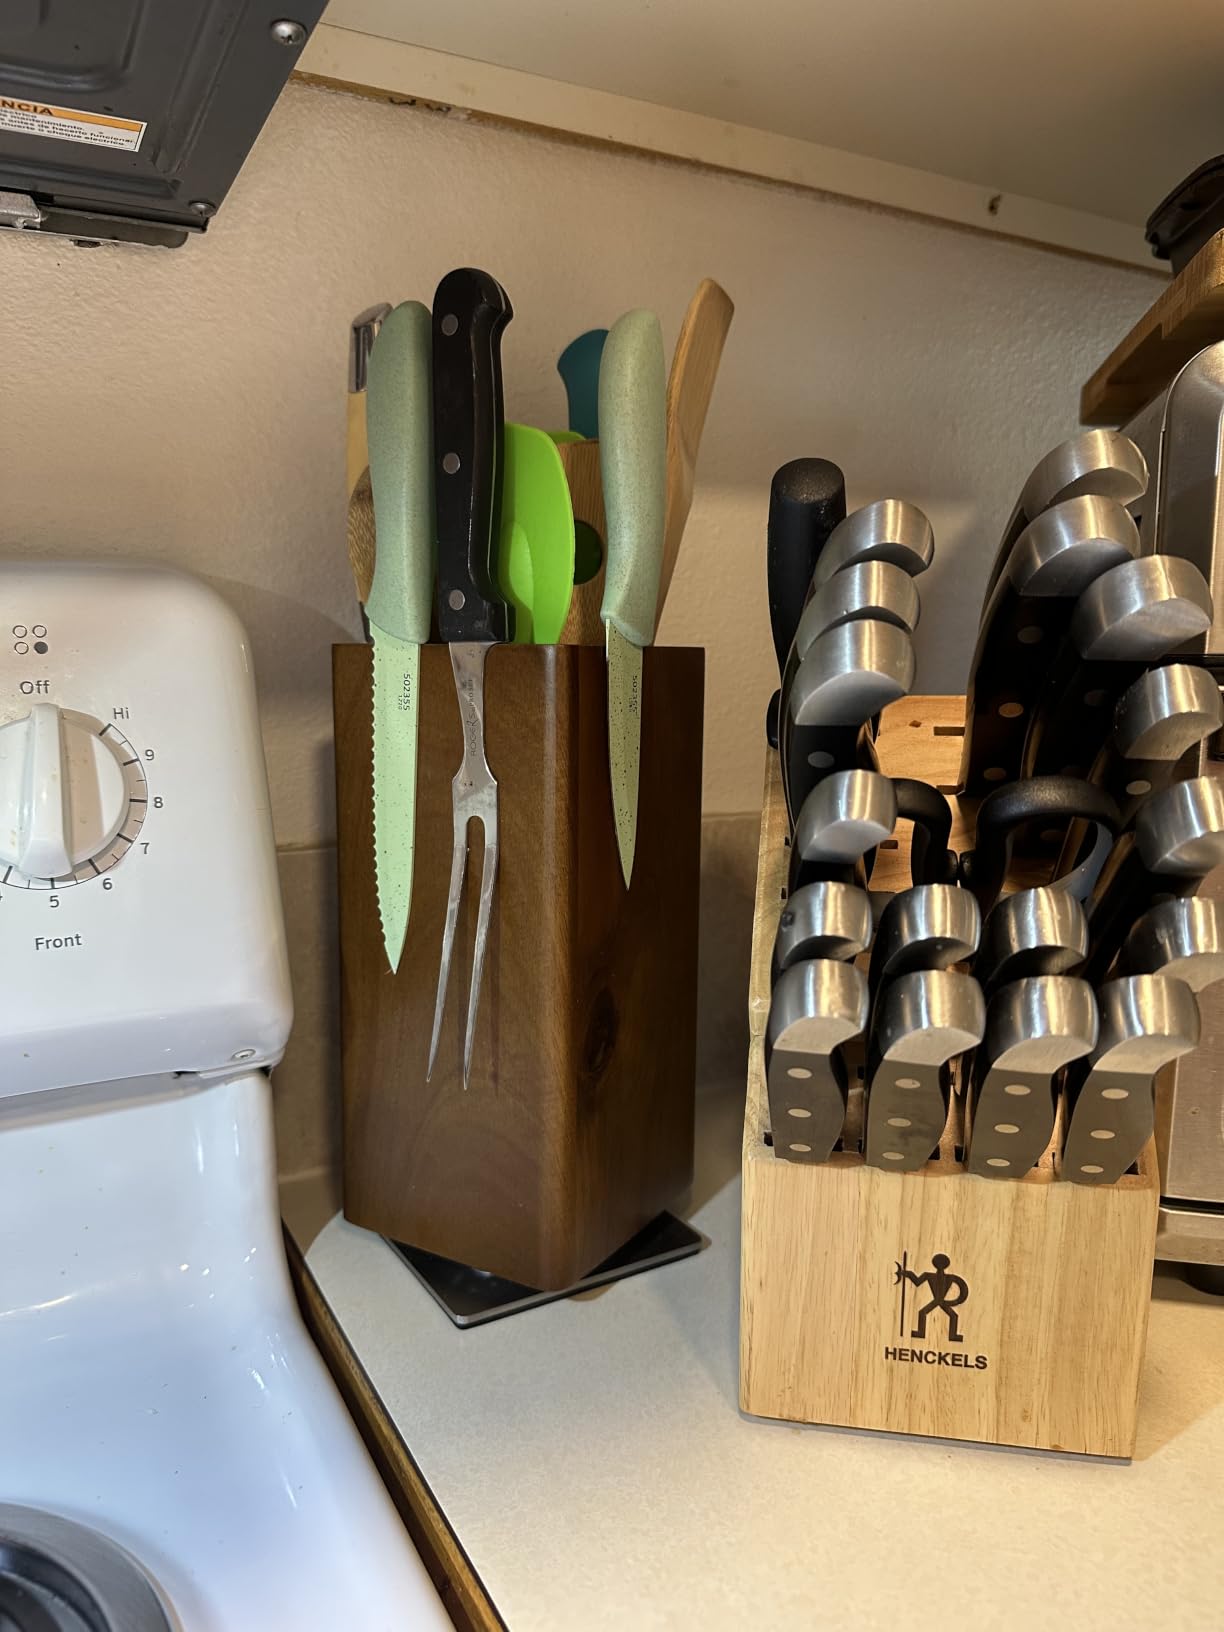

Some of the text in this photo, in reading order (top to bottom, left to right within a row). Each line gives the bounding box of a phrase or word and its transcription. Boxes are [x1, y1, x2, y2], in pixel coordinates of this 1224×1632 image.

[1, 99, 54, 116] NCIA
[19, 680, 50, 695] Off
[403, 673, 411, 711] 502355
[113, 707, 130, 720] Hi
[145, 749, 155, 761] 9
[153, 796, 164, 809] 8
[140, 842, 150, 855] 7
[102, 878, 113, 890] 6
[49, 895, 60, 908] 5
[35, 933, 82, 951] Front
[884, 1346, 988, 1370] HENCKELS
